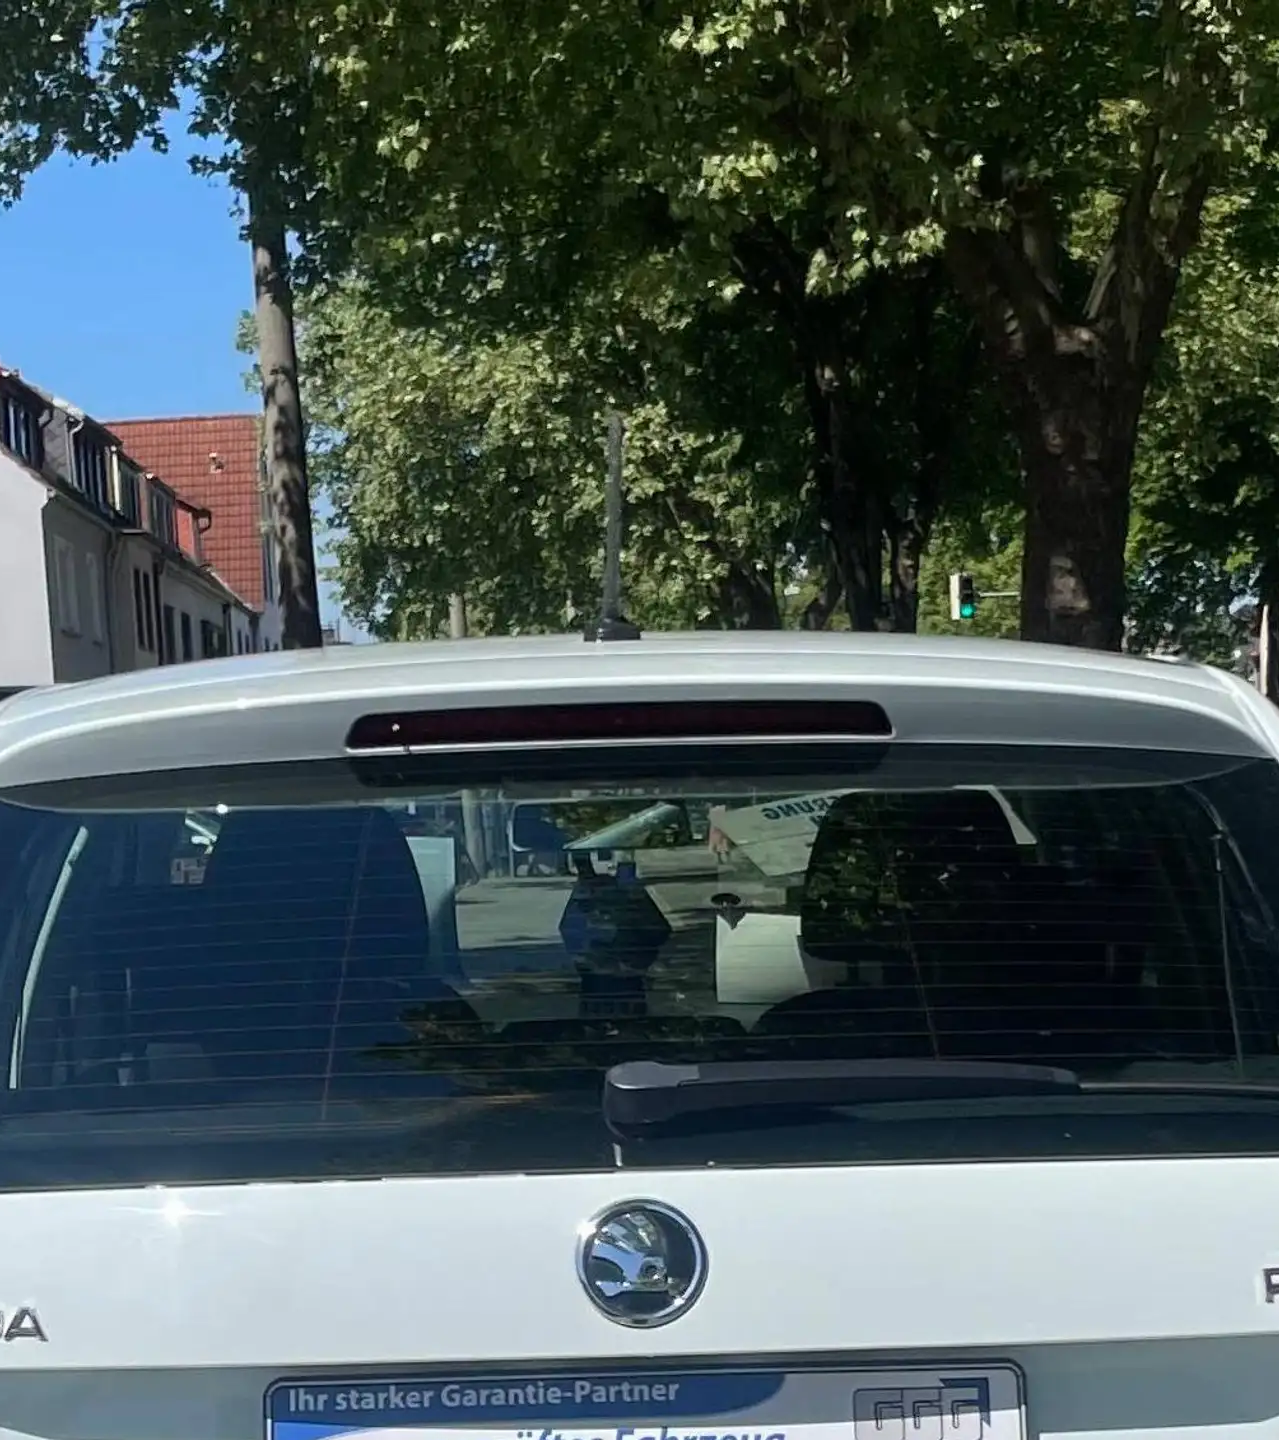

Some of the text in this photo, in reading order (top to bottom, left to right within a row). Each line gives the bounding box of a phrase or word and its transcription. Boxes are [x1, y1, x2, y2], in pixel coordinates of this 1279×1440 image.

[288, 1379, 680, 1413] Ihr starker Garantie-Partner
